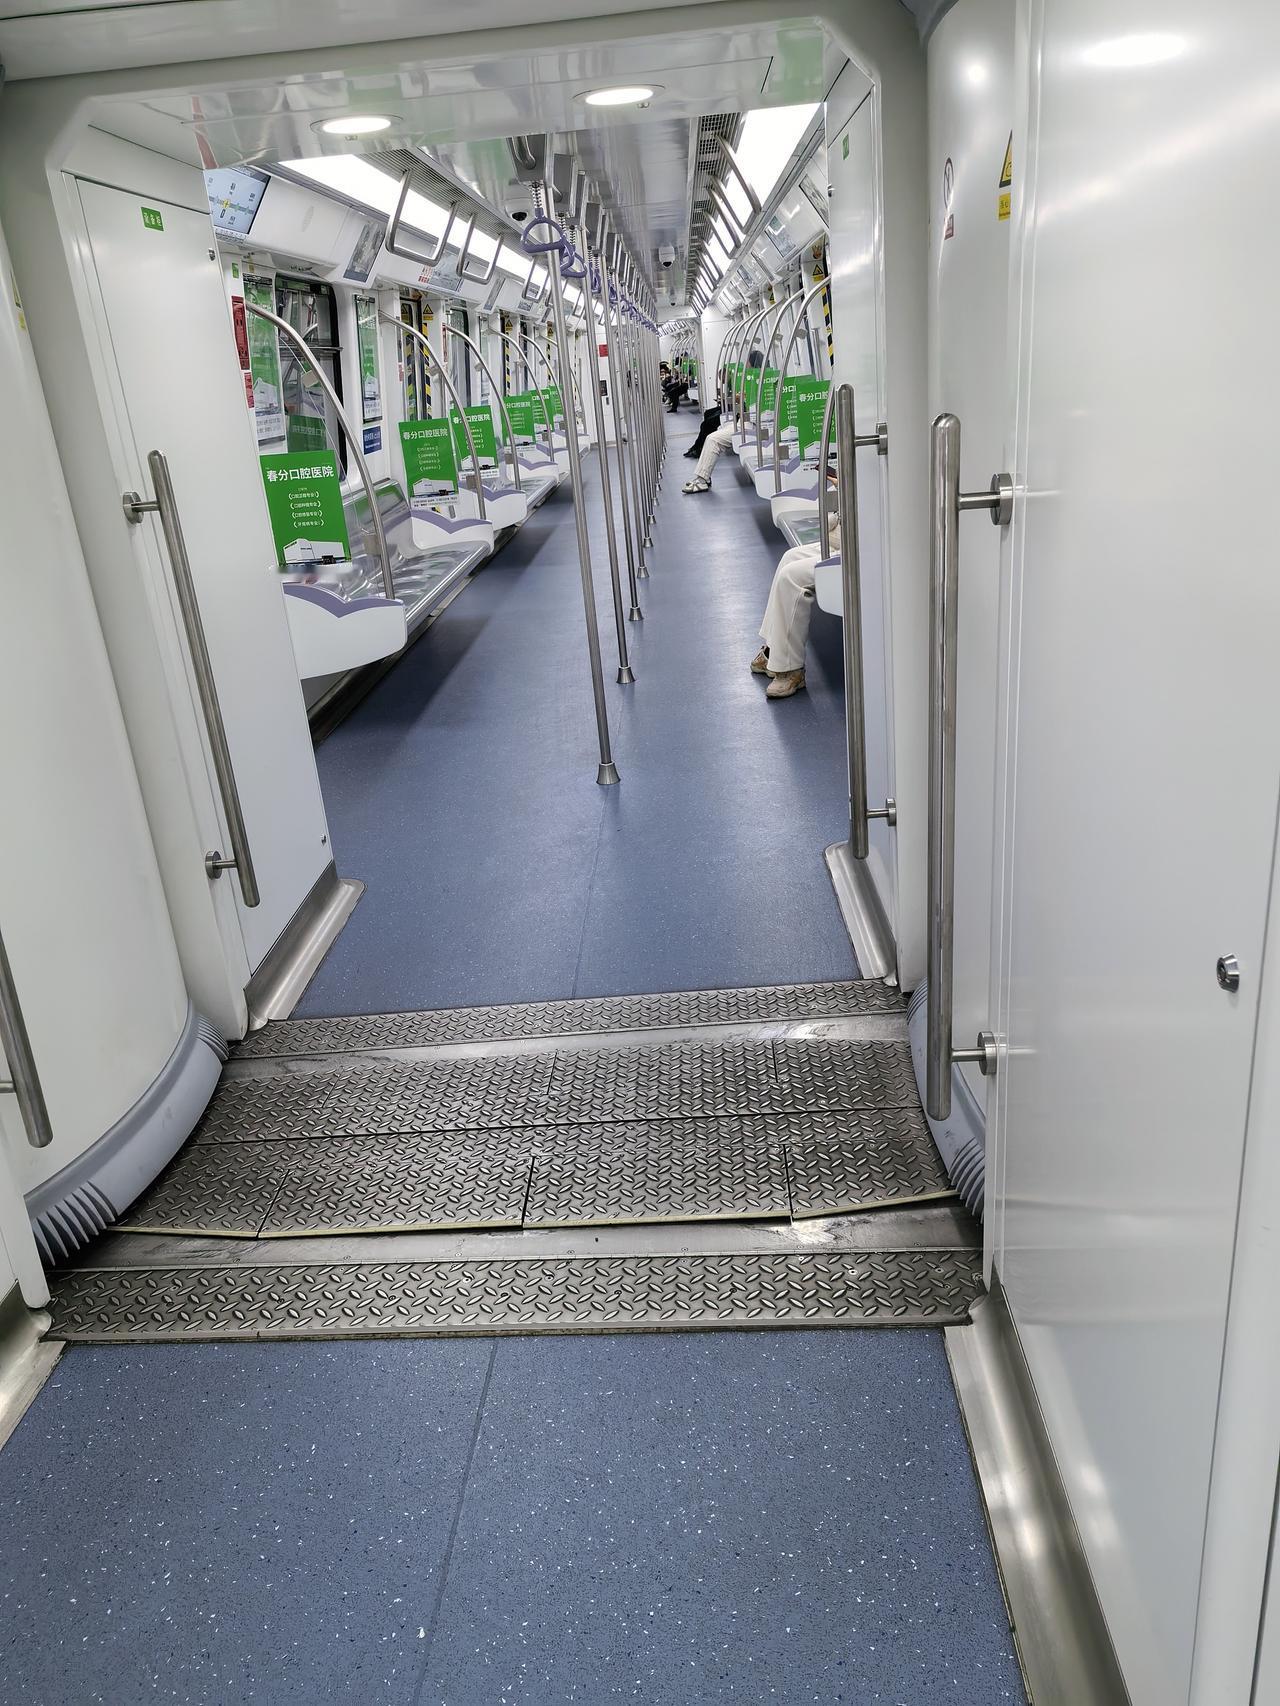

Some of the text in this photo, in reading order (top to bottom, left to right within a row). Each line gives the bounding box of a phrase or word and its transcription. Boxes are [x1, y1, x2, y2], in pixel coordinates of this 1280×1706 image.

[403, 428, 448, 440] 春分口腔医院
[267, 465, 335, 482] 春分口腔医院
